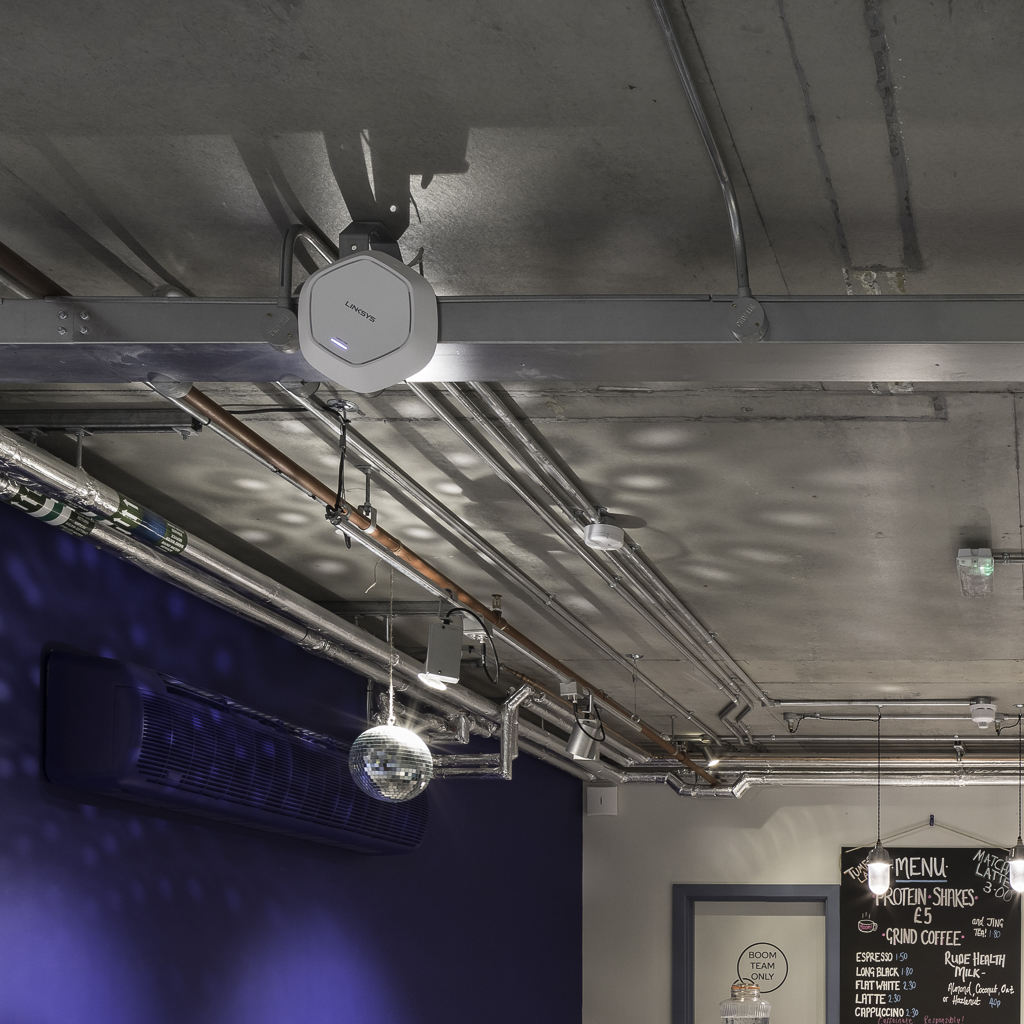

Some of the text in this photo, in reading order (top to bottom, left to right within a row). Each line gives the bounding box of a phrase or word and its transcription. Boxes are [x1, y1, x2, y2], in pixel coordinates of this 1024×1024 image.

[895, 856, 947, 880] MENU
[975, 862, 1011, 890] LATTE
[875, 886, 975, 908] PROTEIN SHAKES
[971, 916, 1005, 929] and JING
[885, 927, 962, 946] GRIND COFFEE
[748, 951, 777, 959] BOOM
[856, 952, 893, 963] ESPRESSO
[750, 962, 775, 970] TEAM
[751, 972, 774, 980] ONLY
[855, 967, 875, 977] LONG
[876, 967, 900, 978] BLACK
[855, 980, 875, 991] FLAT
[875, 980, 901, 991] WHITE
[855, 993, 887, 1005] LATTE
[854, 1007, 905, 1018] CAPPUCCINO
